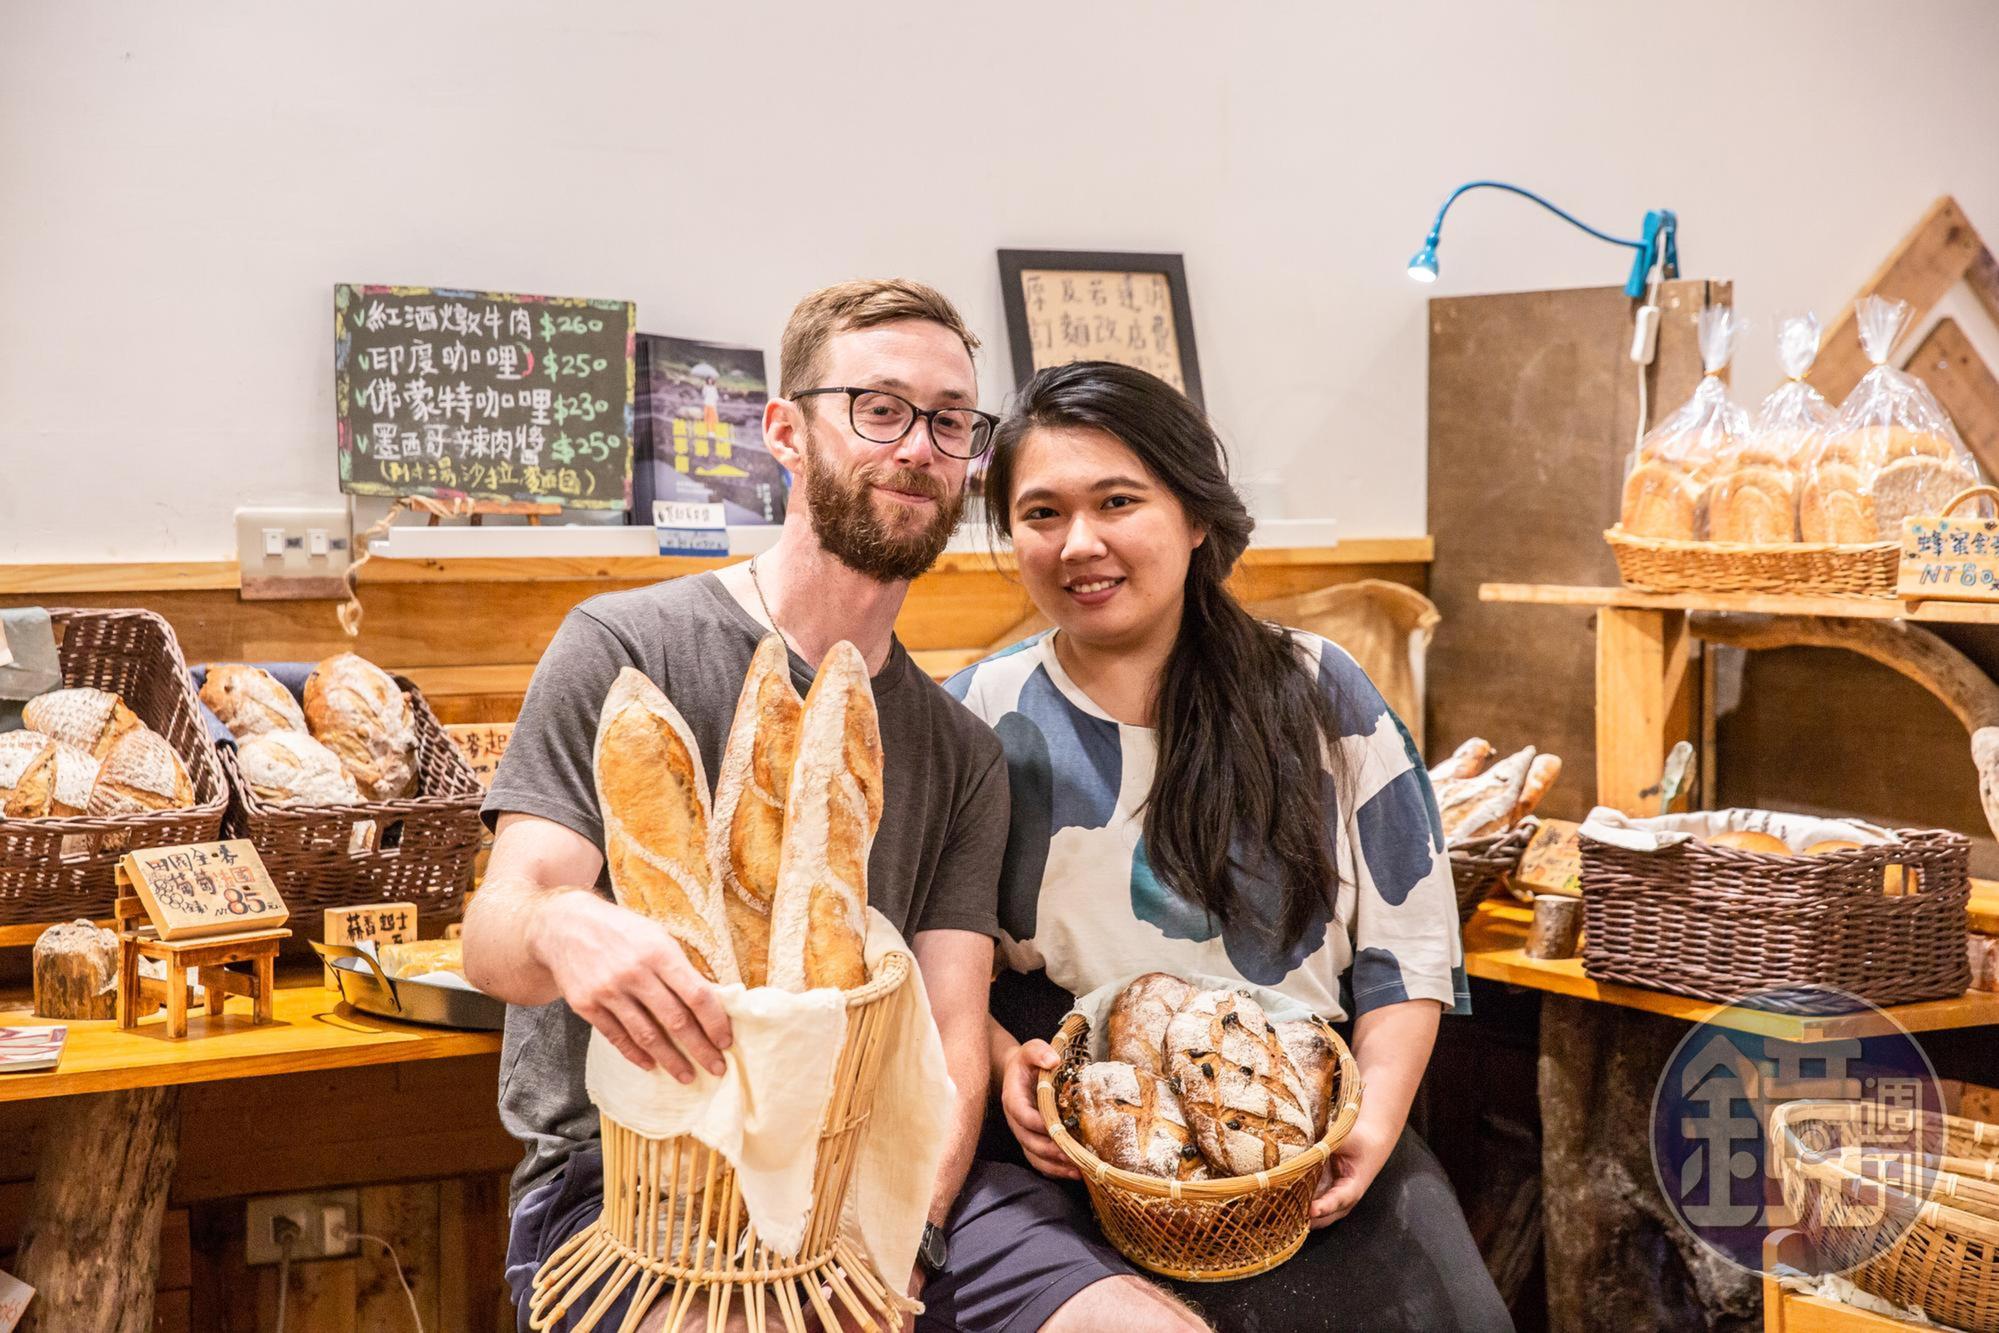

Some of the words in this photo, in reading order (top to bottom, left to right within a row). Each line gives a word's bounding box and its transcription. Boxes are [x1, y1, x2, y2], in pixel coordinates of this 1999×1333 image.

[540, 311, 604, 342] $260
[367, 339, 522, 380] 印度咖哩
[542, 348, 608, 382] $250
[367, 377, 552, 426] 佛蒙特咖哩
[553, 392, 609, 426] $230
[372, 422, 547, 466] 墨西哥辣肉醬
[551, 432, 621, 464] $250
